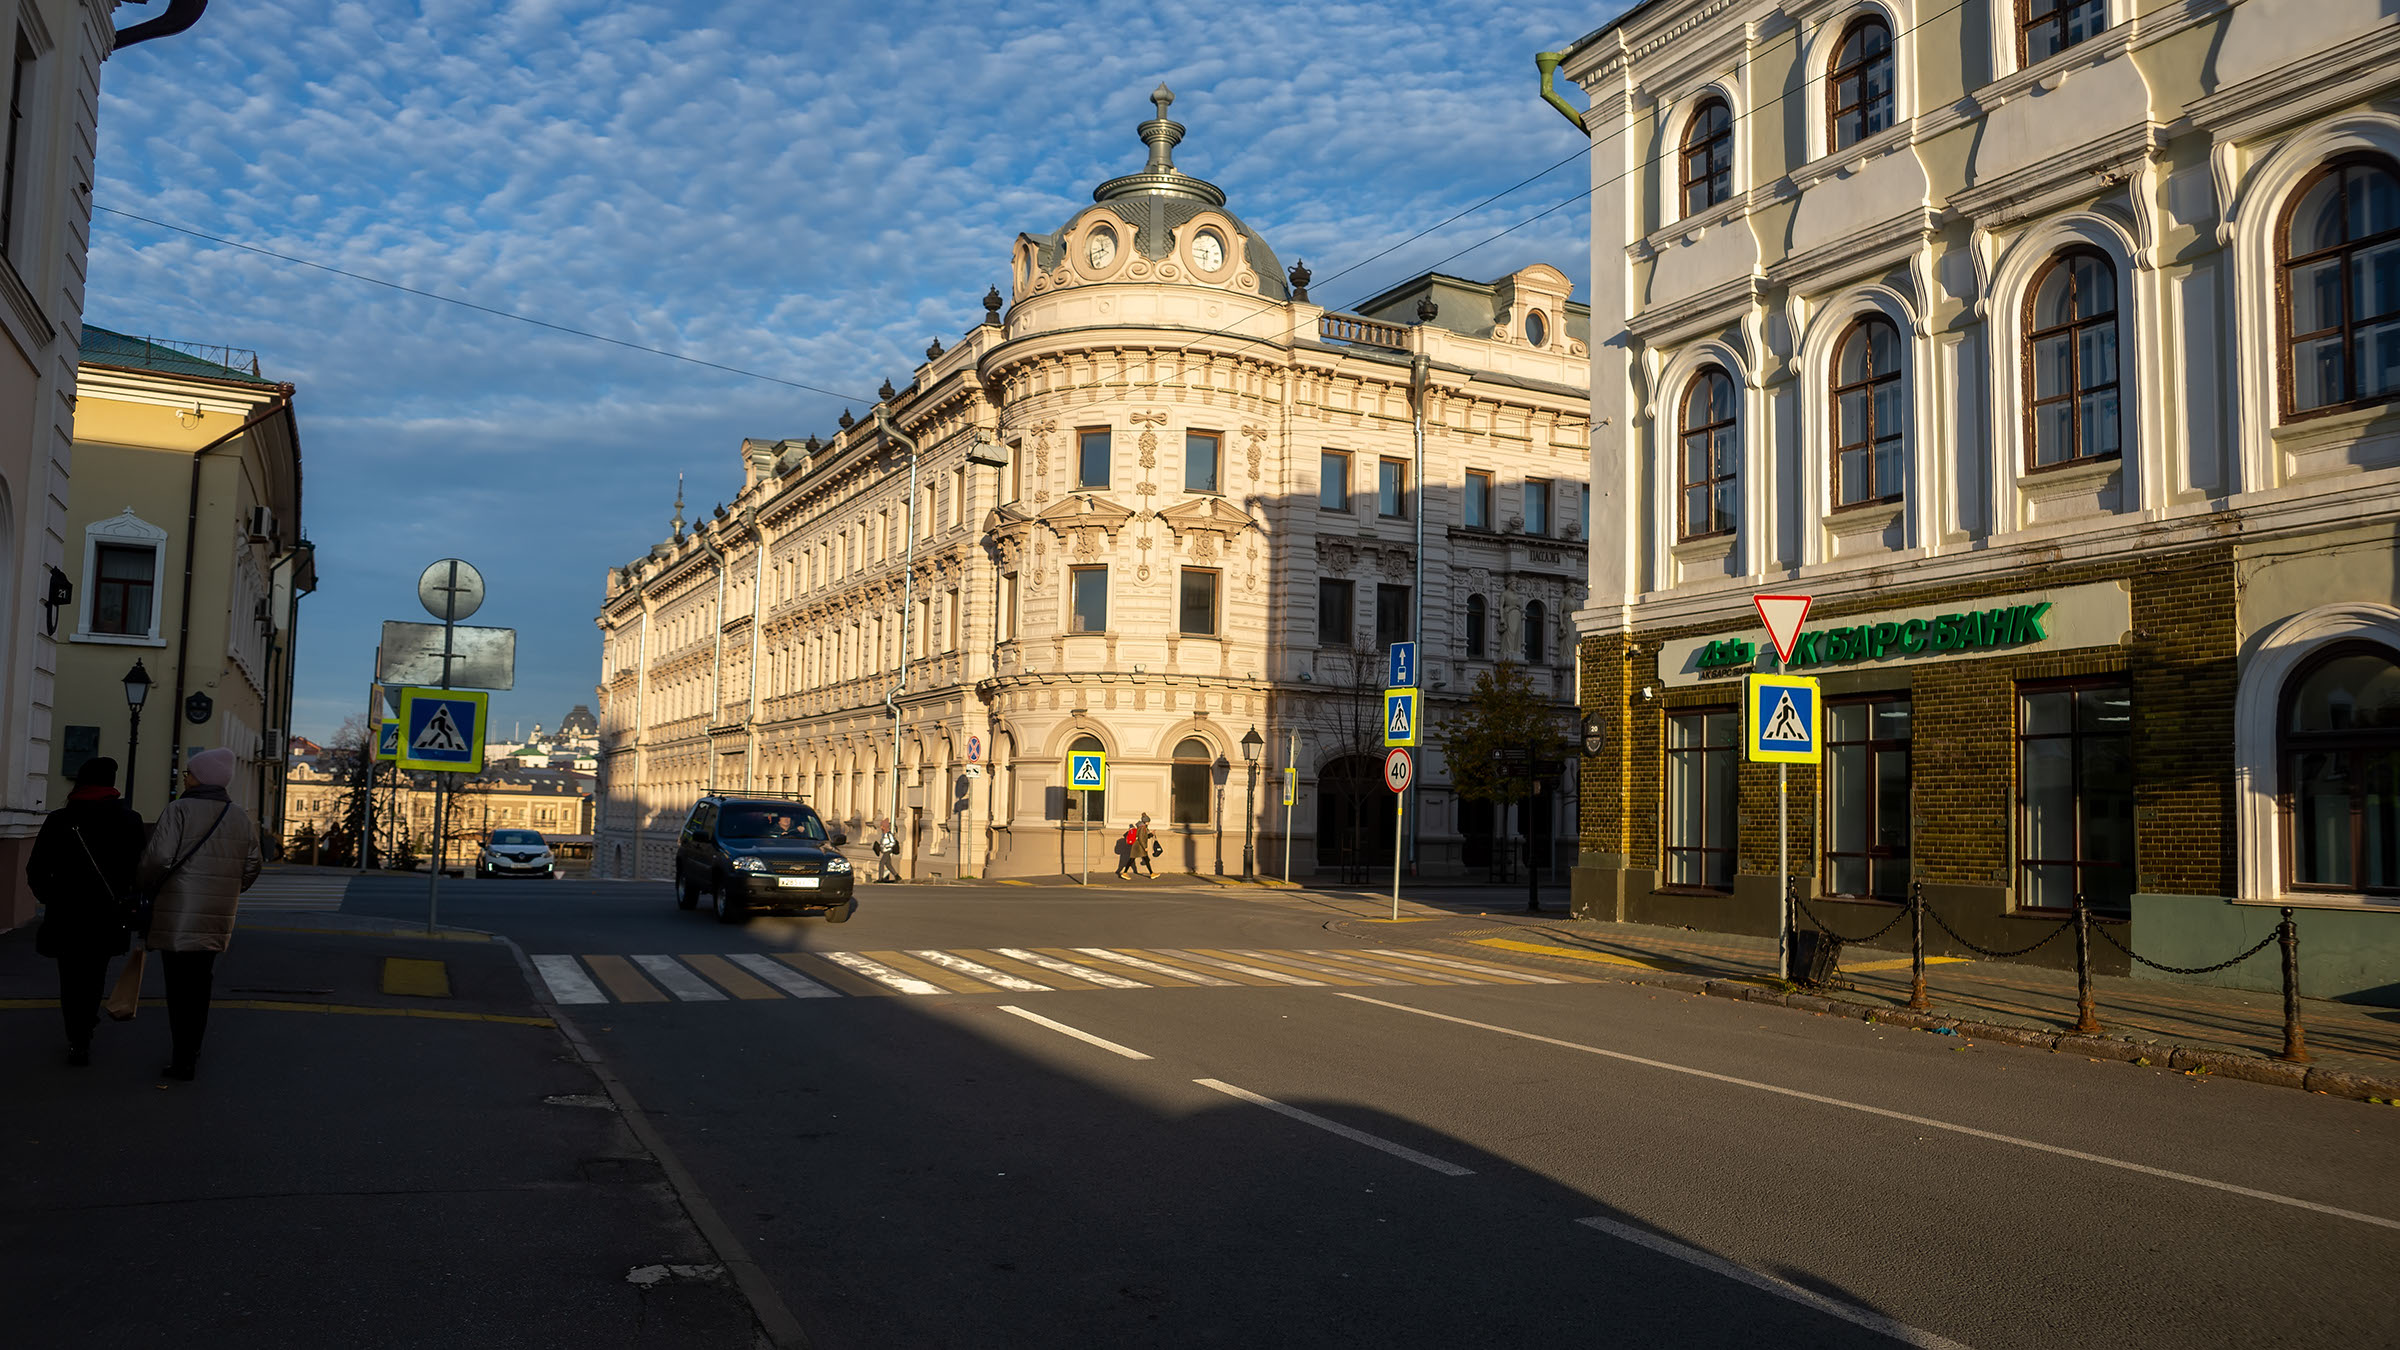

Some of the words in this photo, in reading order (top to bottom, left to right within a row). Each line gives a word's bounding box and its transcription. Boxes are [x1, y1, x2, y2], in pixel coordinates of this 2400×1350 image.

[58, 588, 67, 599] 21
[1824, 618, 1929, 662] БАРС
[1930, 602, 2053, 651] БАНК
[1391, 762, 1407, 780] 40
